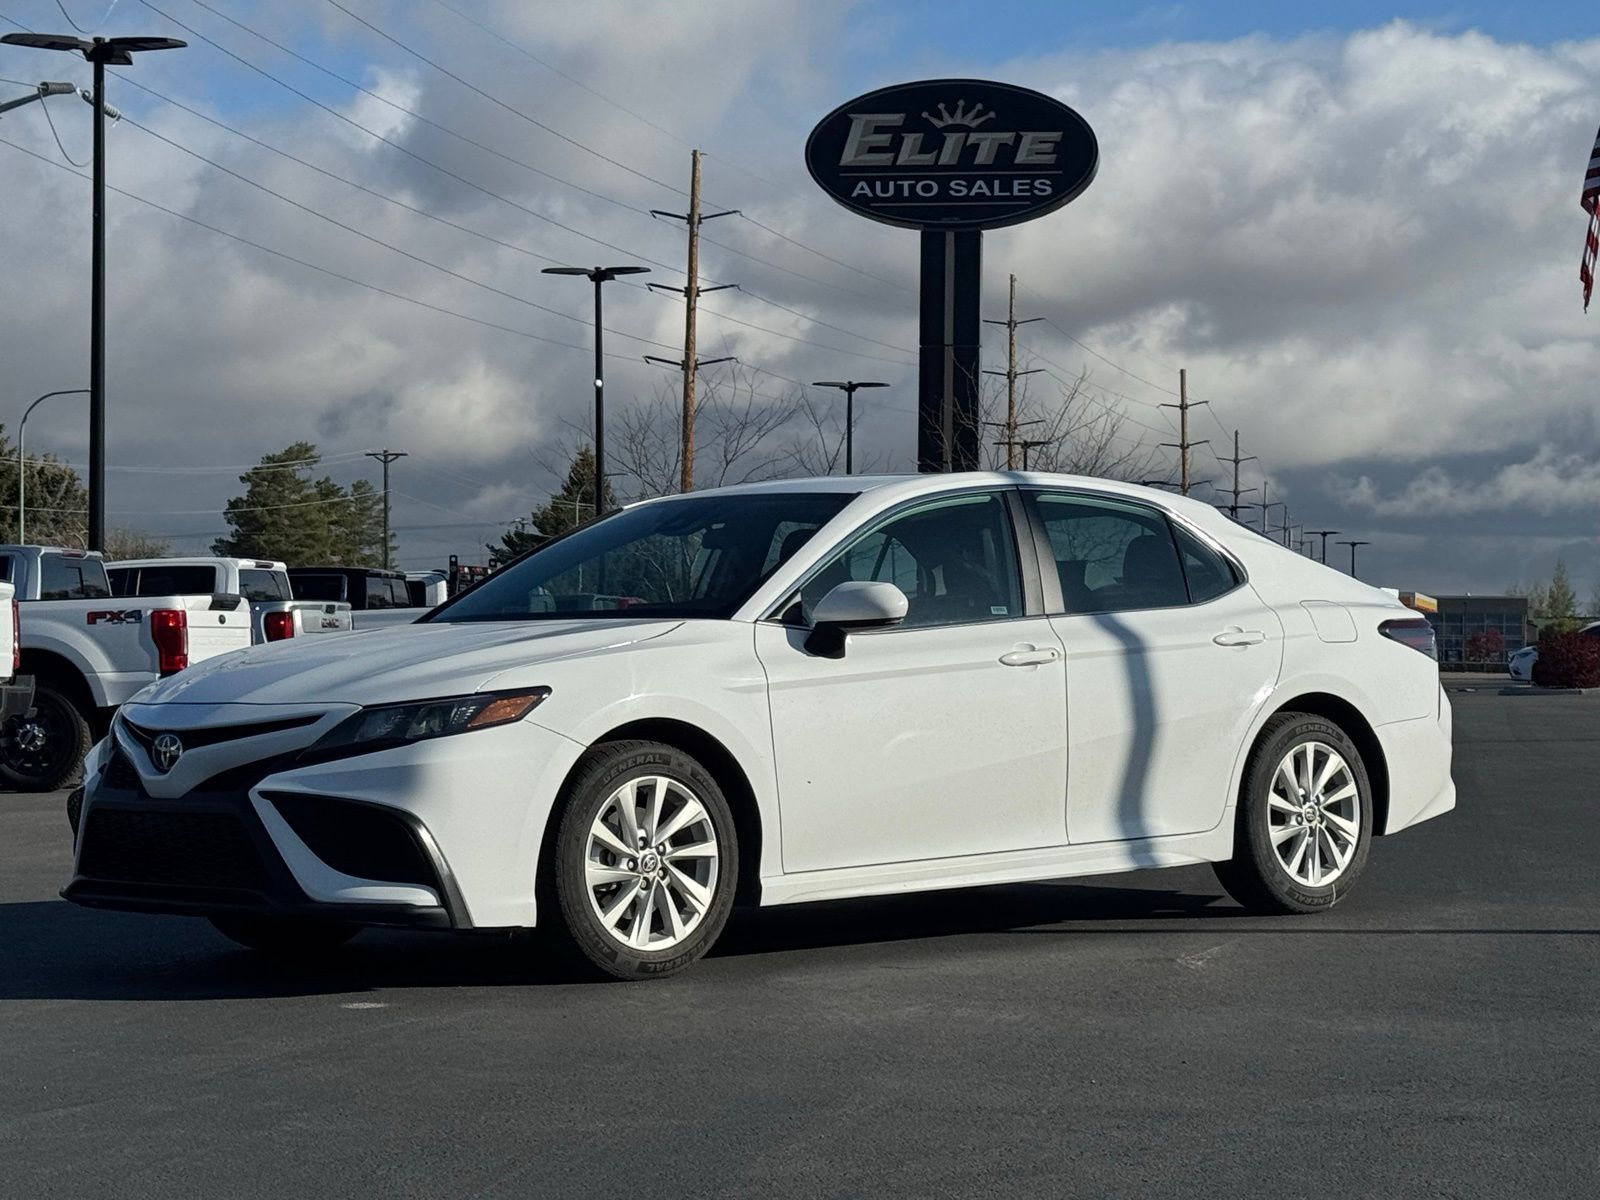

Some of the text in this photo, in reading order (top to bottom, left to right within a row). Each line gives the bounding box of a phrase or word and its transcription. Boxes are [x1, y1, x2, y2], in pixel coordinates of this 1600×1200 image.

[839, 113, 1063, 166] ELITE
[851, 179, 1053, 197] AUTO SALES
[87, 610, 143, 625] FX4
[1295, 724, 1339, 737] GENERAL
[603, 754, 663, 783] GENERAL
